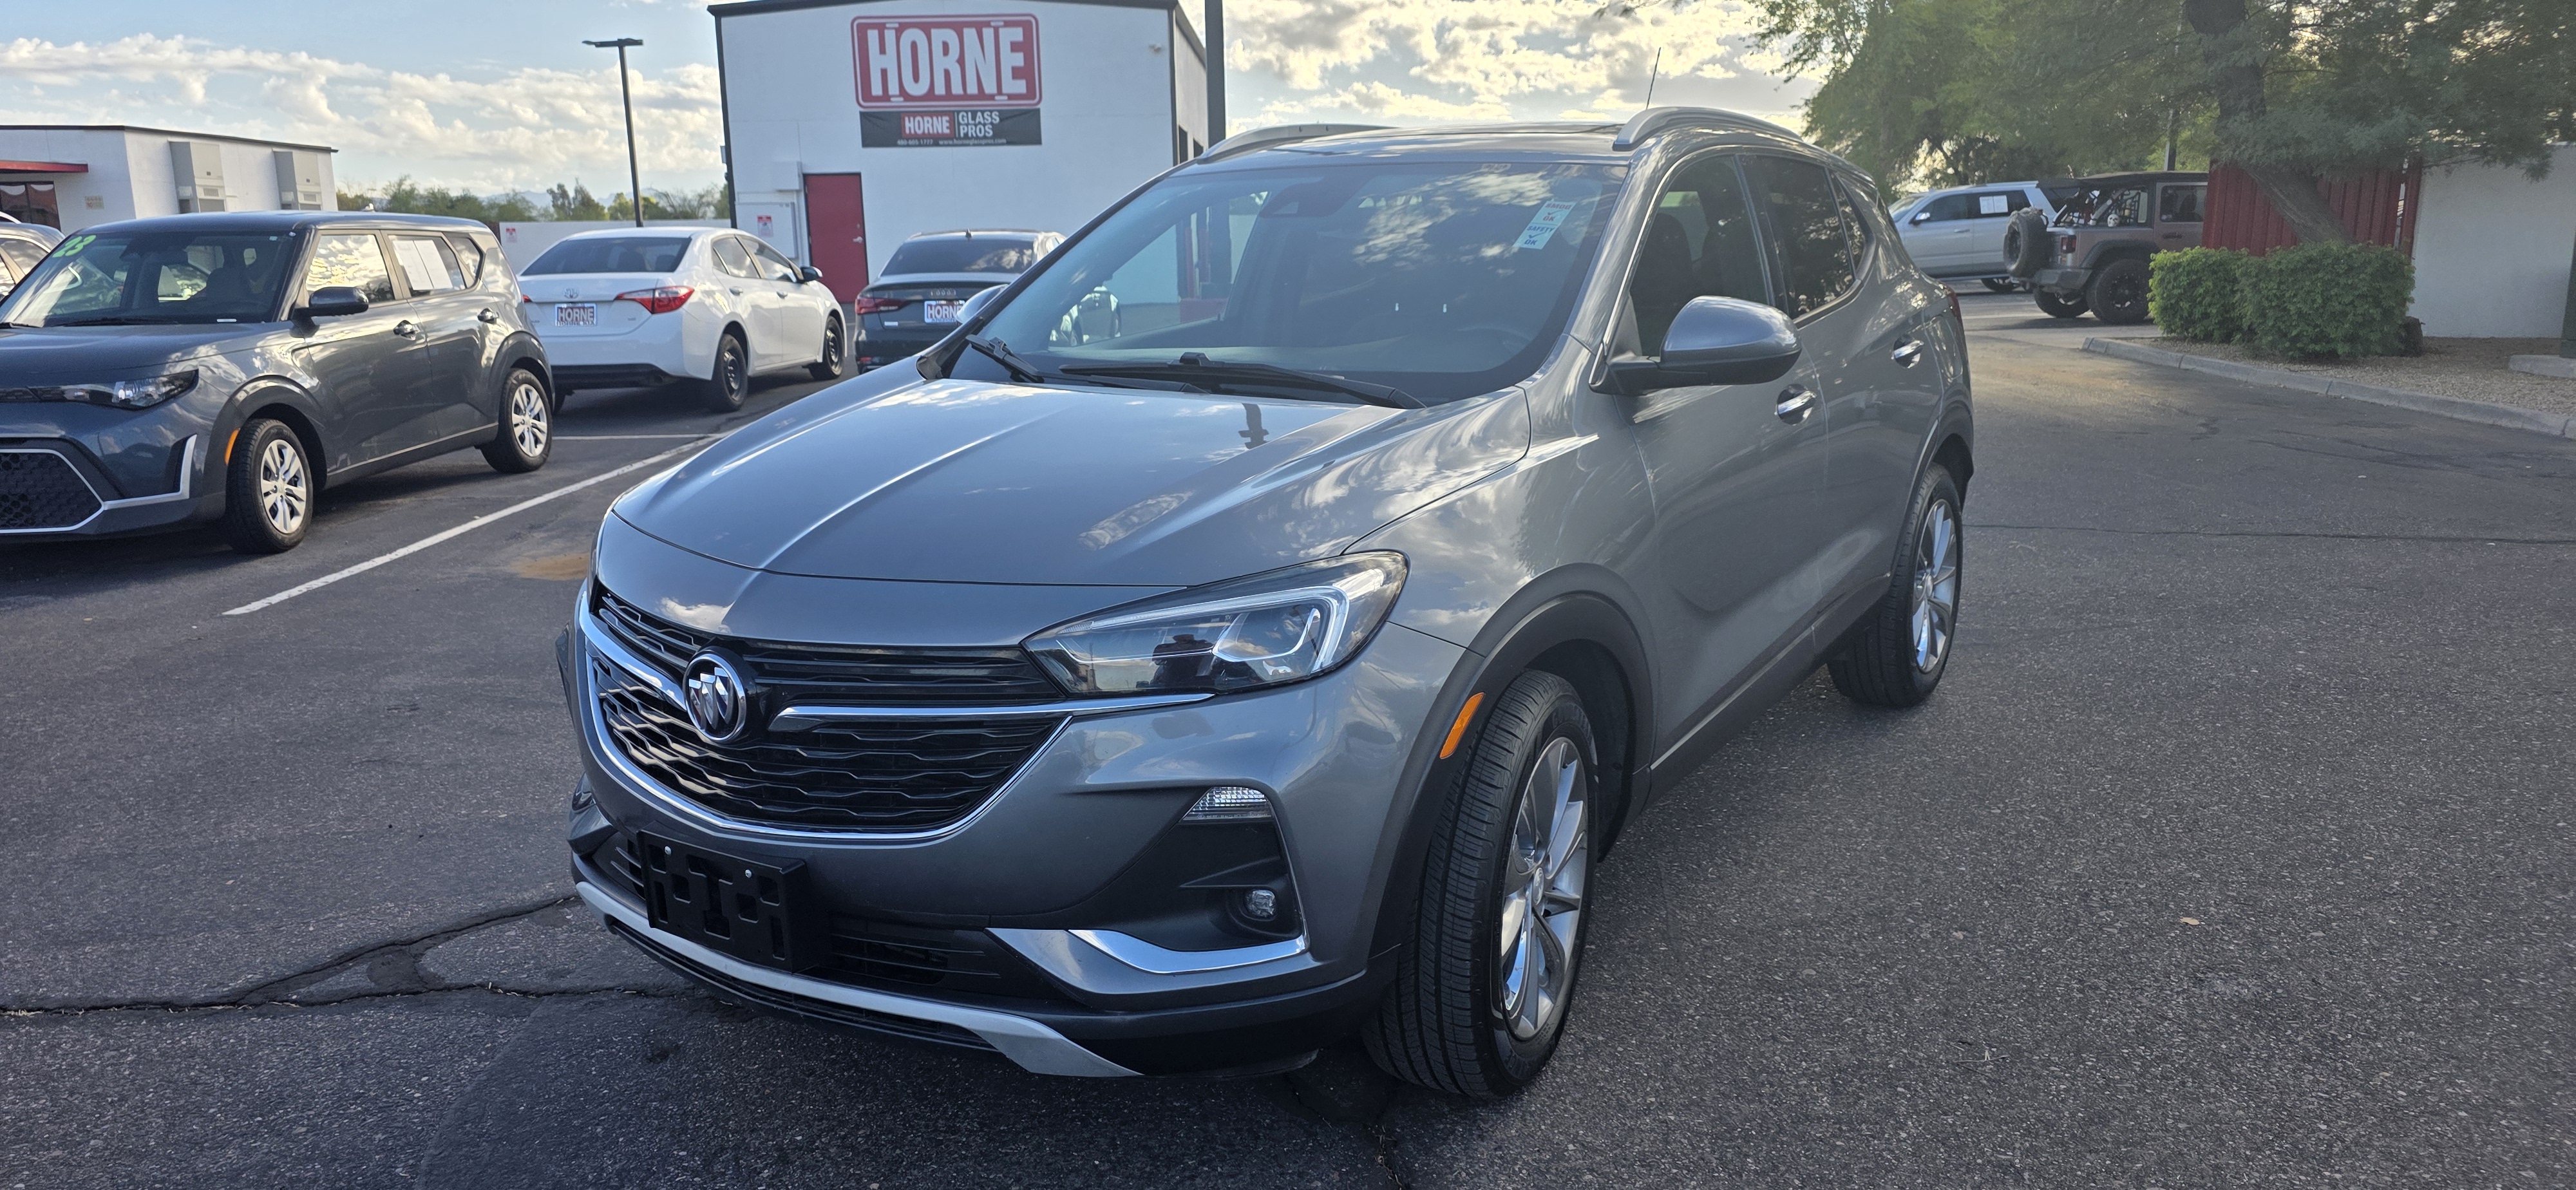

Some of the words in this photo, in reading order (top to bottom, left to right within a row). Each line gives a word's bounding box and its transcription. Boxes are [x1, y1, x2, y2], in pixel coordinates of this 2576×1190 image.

[867, 27, 1027, 97] HORNE
[905, 116, 950, 134] HORNE
[959, 111, 999, 124] GLASS
[960, 125, 993, 137] PROS
[52, 235, 96, 258] 23
[558, 308, 593, 321] HORNE
